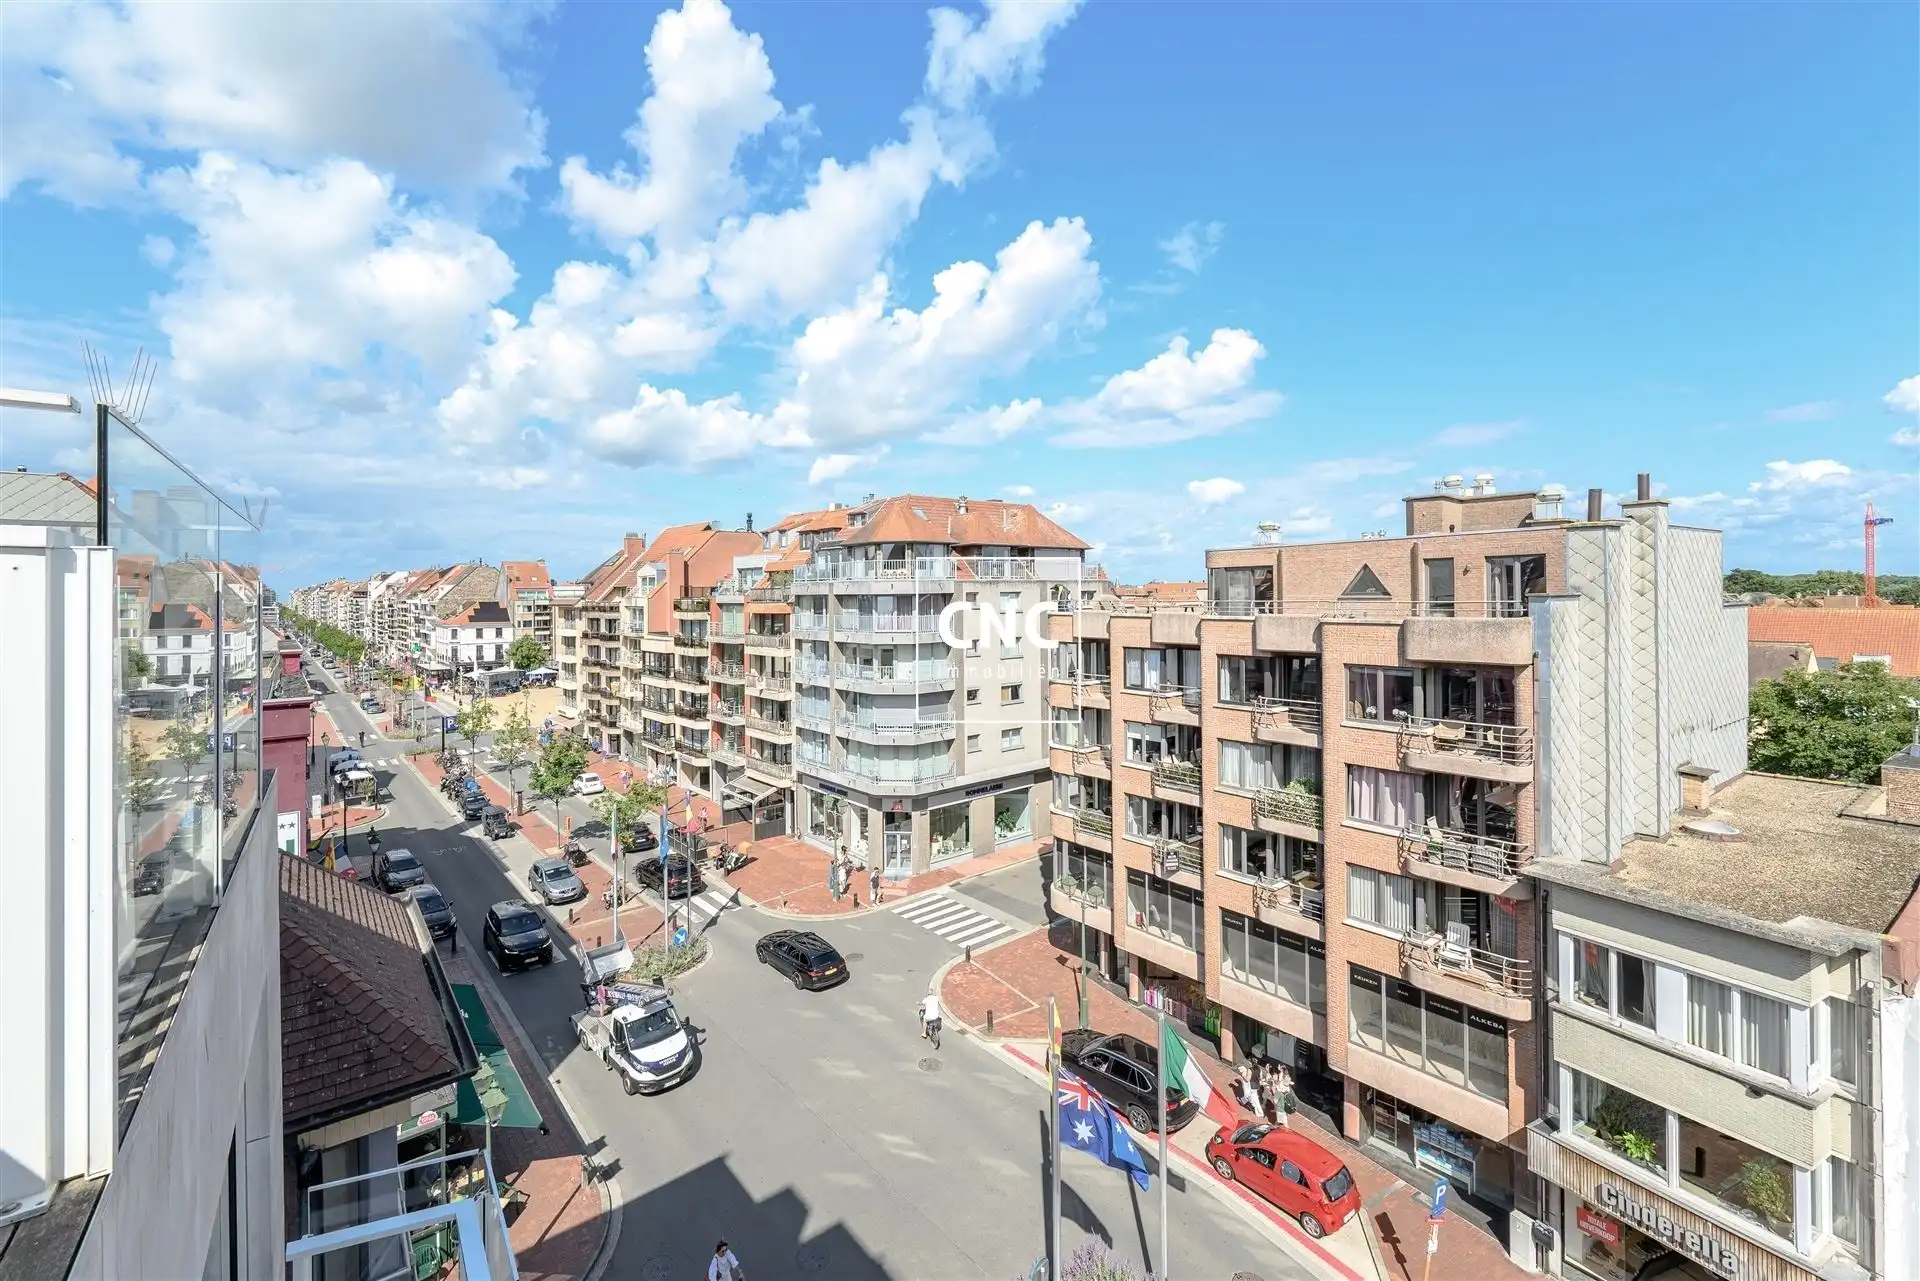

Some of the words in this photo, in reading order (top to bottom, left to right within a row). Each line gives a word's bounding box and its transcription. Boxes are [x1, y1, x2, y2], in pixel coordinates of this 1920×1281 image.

[1353, 974, 1378, 986] KEUKEN
[1469, 1015, 1505, 1031] ALKEBA
[1435, 1185, 1447, 1205] P
[1586, 1214, 1607, 1231] TOTALE
[1601, 1183, 1740, 1274] Cinderella
